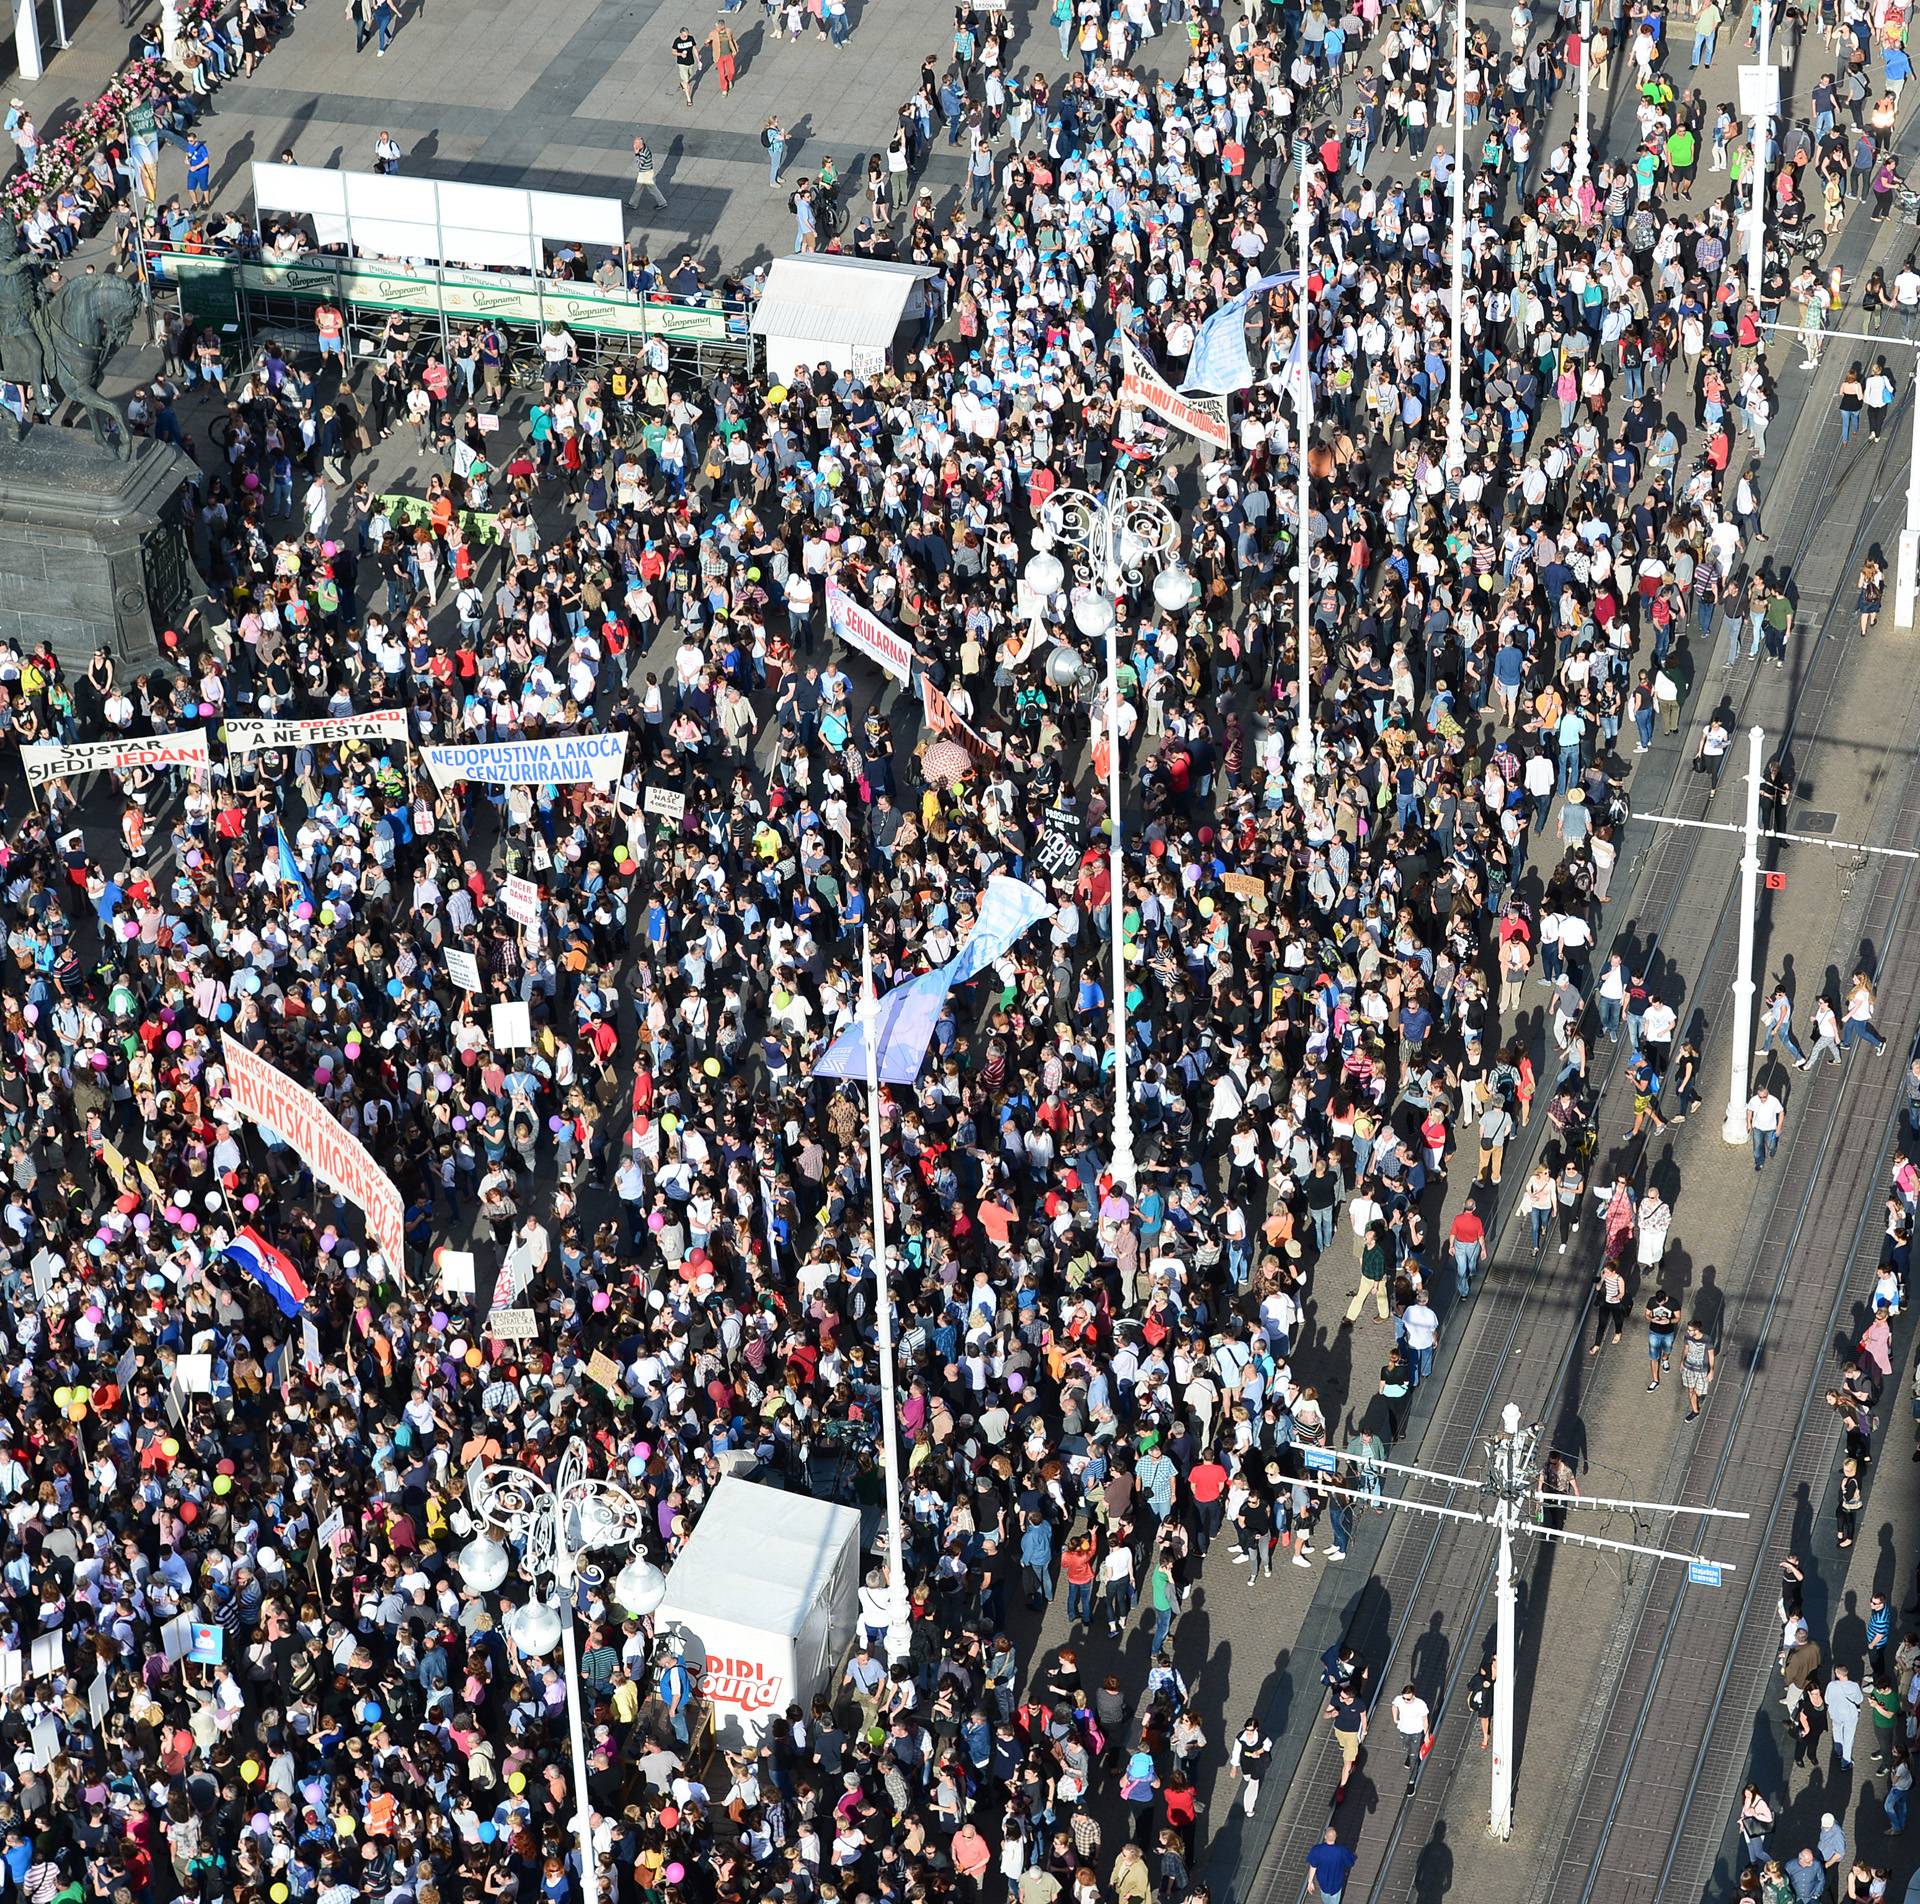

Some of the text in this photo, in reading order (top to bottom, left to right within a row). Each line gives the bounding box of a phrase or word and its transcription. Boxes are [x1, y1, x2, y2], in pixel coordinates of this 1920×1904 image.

[286, 270, 336, 290] Staropramen
[379, 280, 427, 301] Staropramen
[473, 290, 522, 311] Staropramen
[567, 300, 616, 321] Staropramen
[662, 311, 712, 332] Staropramen
[846, 606, 908, 668] SEKULARNA!
[226, 721, 264, 733] OVO
[252, 724, 383, 745] A NE FESTA!
[431, 735, 622, 767] NEDOPUSTIVA LAKOĆA
[28, 758, 93, 781] SJEDI
[466, 760, 593, 782] CENZURIRANJA
[1771, 874, 1780, 887] S
[224, 1041, 274, 1085] HRVATSKA
[226, 1064, 314, 1160] HRVATSKA
[318, 1131, 364, 1199] MORA
[705, 1654, 764, 1681] DIDI
